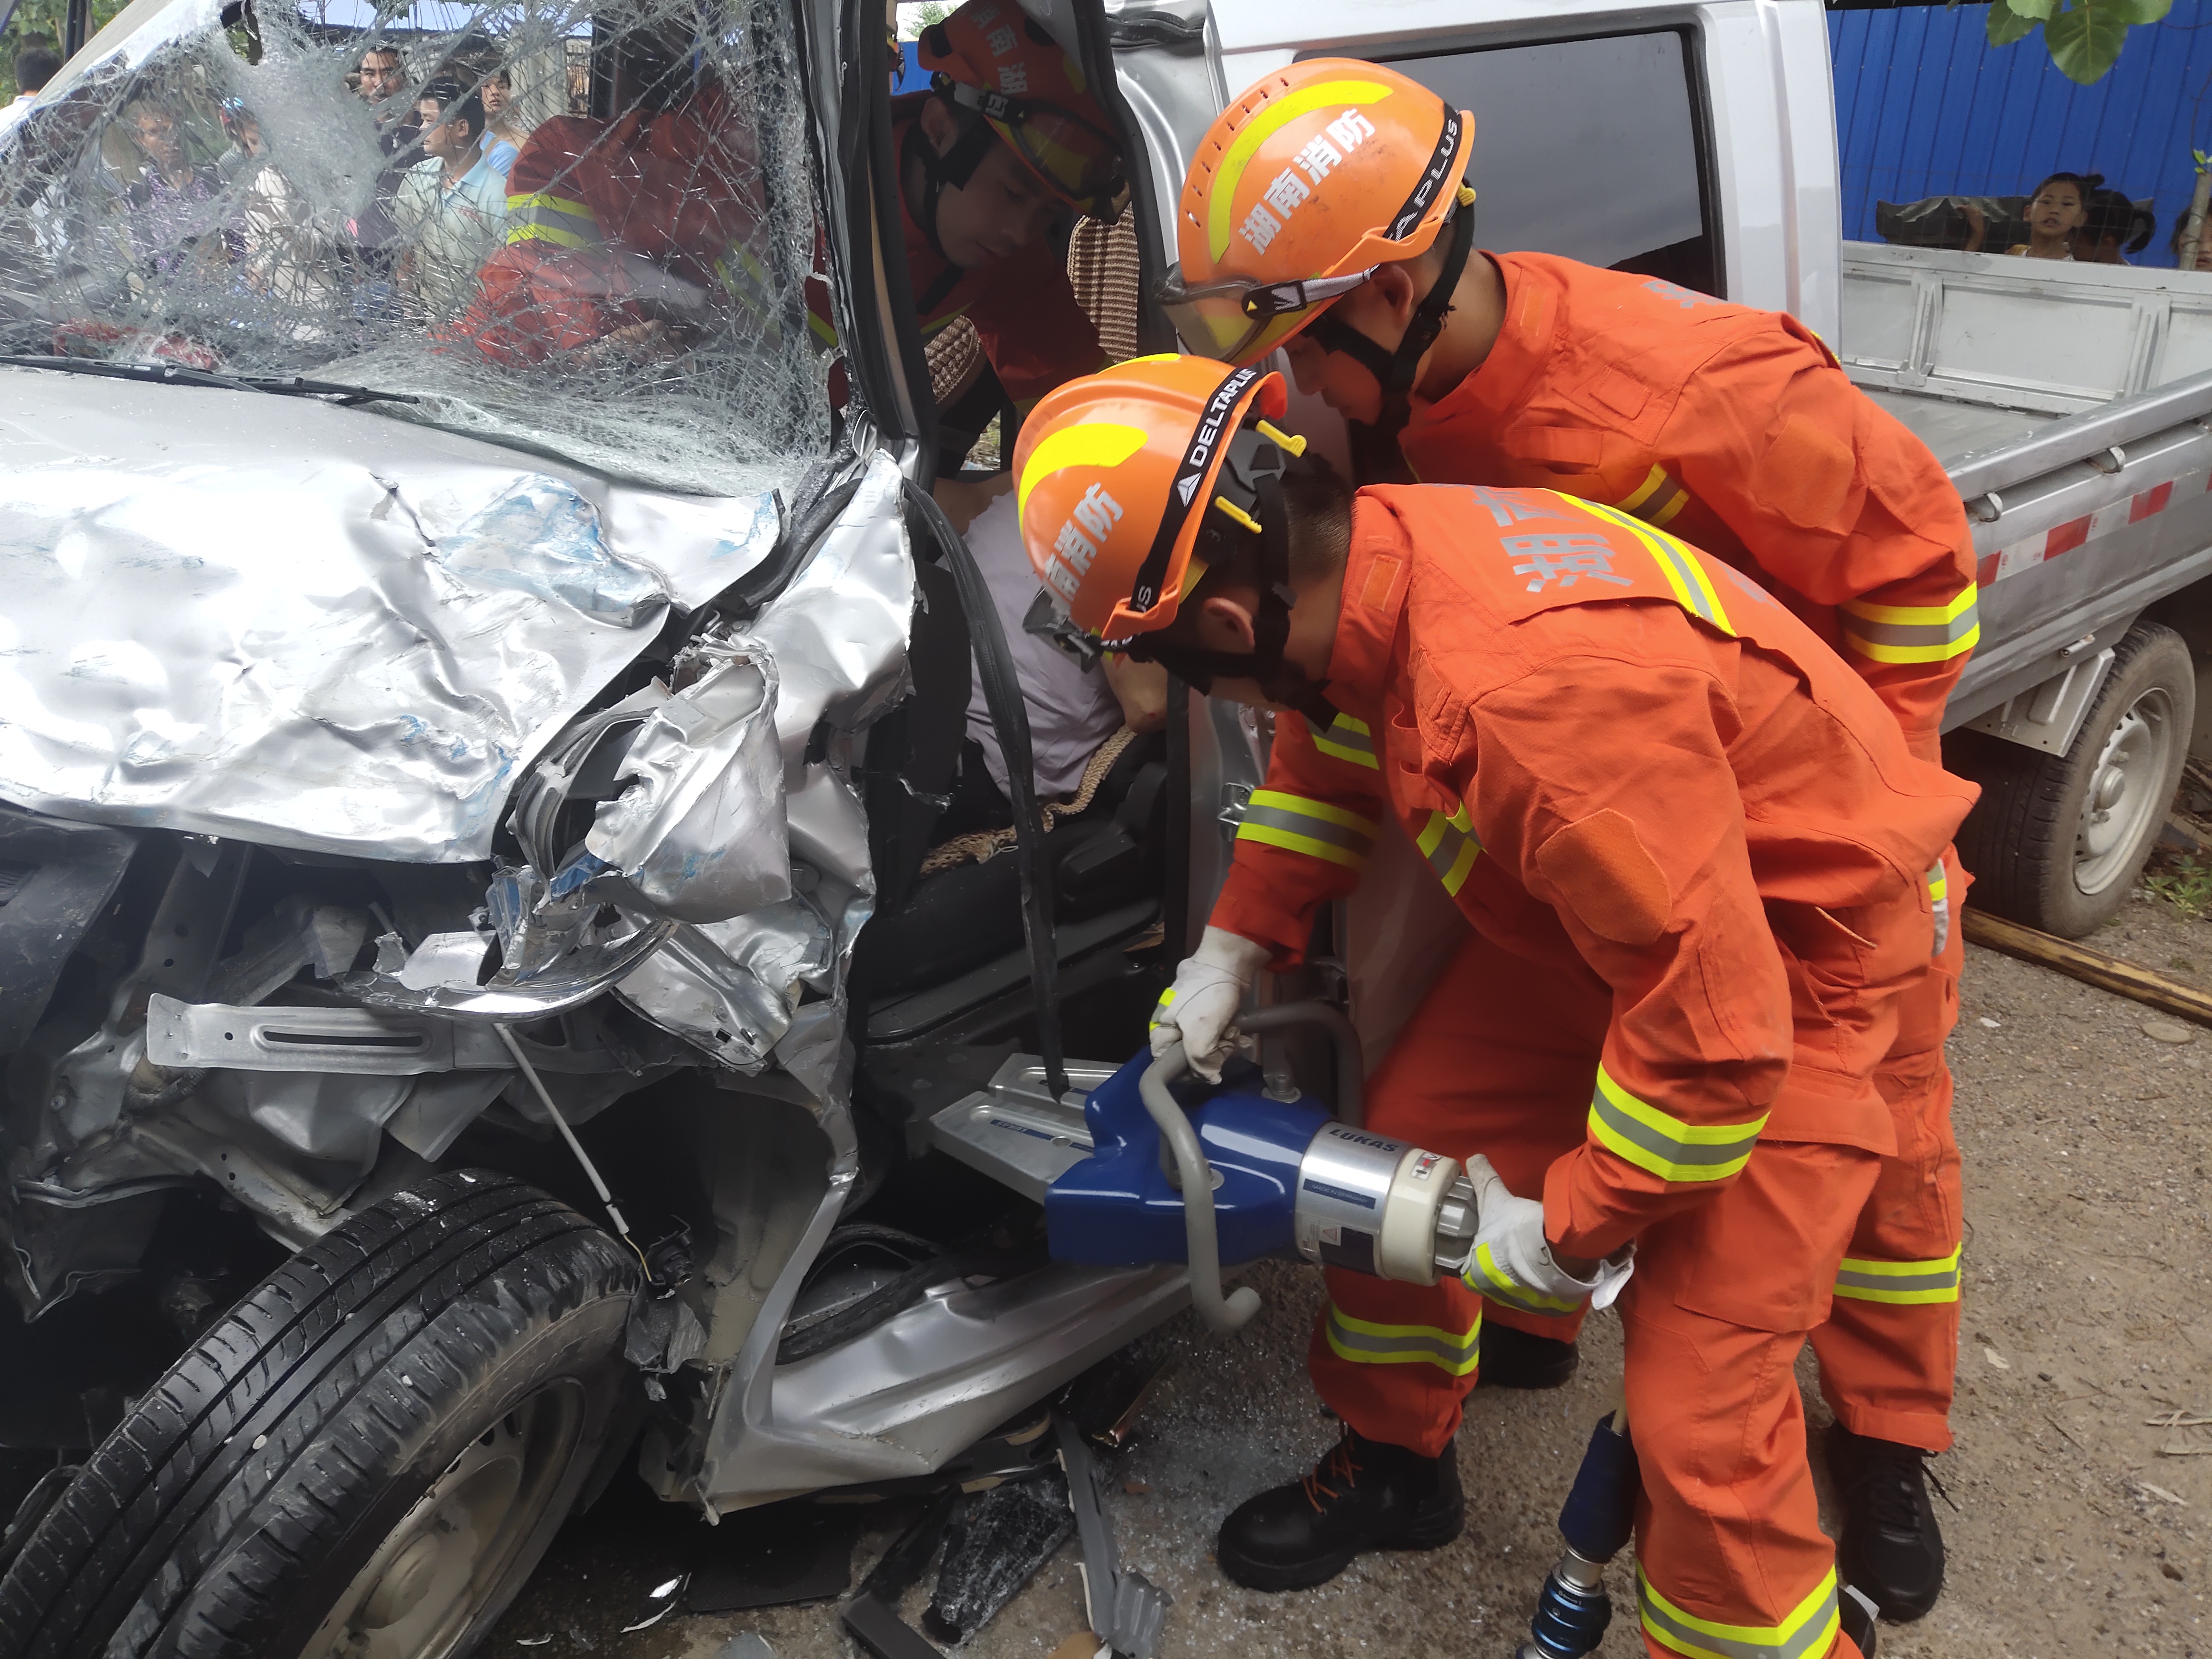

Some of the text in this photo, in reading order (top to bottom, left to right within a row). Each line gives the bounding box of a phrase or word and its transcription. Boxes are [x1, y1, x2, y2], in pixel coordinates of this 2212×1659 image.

[1238, 108, 1375, 255] 湖南消防
[1388, 119, 1458, 241] APLUS
[1189, 368, 1257, 468] DELTAPLUS
[1044, 482, 1124, 621] 南消防
[1329, 1129, 1399, 1152] LUKAS
